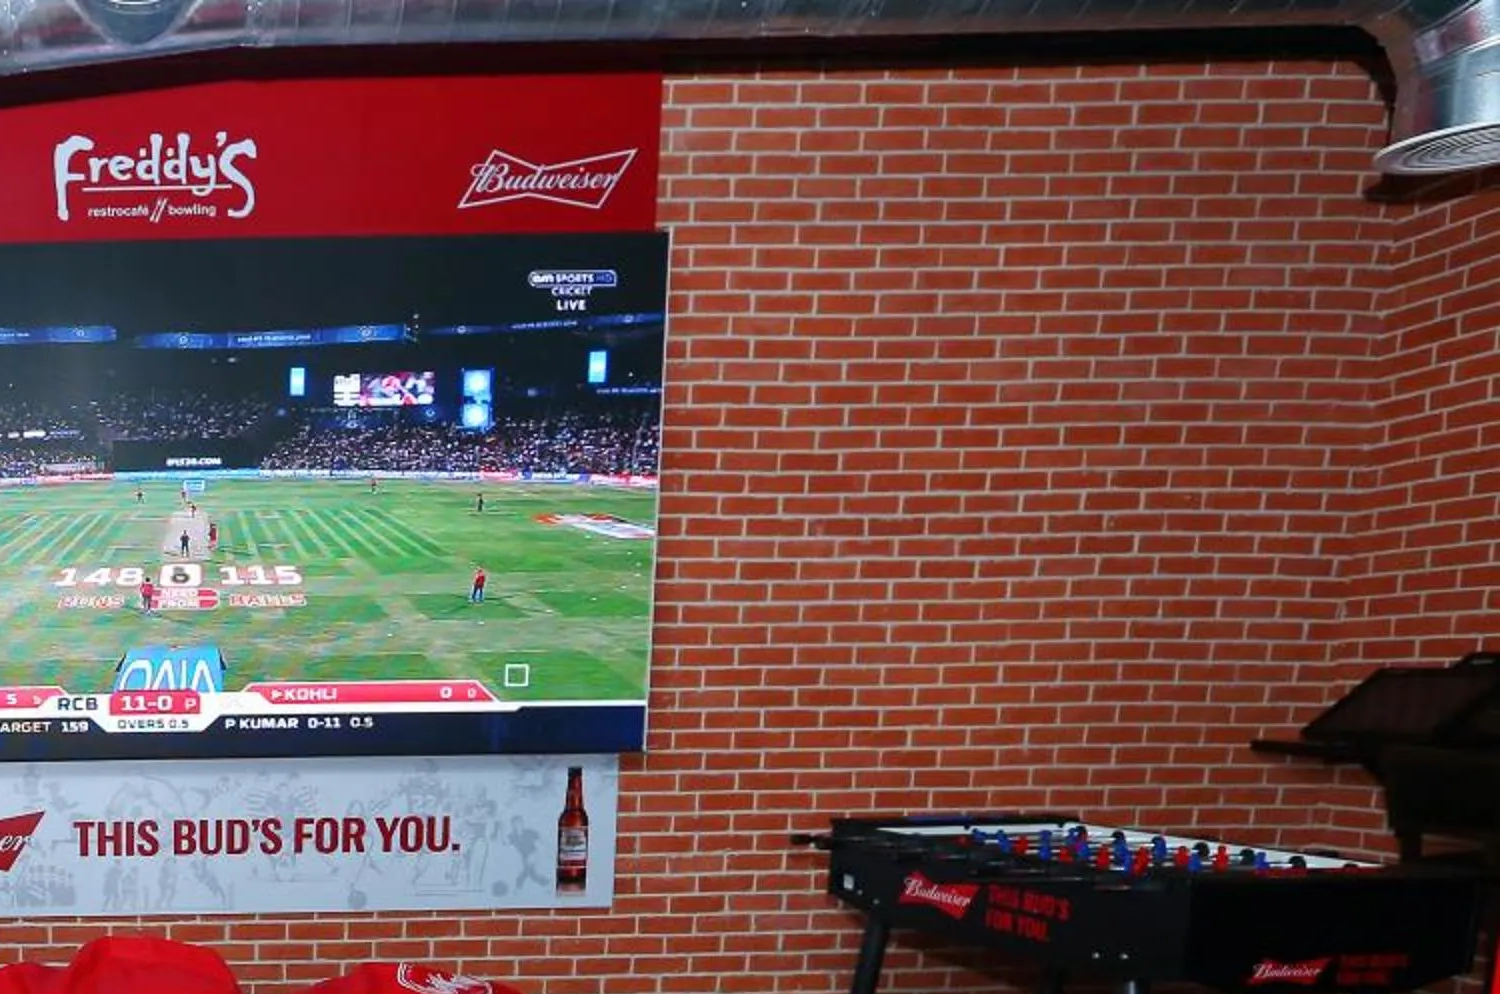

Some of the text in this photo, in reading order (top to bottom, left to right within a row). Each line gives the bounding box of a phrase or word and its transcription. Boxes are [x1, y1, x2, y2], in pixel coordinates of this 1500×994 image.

[470, 161, 620, 193] Budweiser
[168, 202, 217, 217] bowling
[557, 299, 587, 311] LIVE
[53, 567, 145, 587] 148
[221, 566, 302, 585] 115
[284, 689, 337, 701] KOHLI
[58, 697, 98, 711] RCB
[122, 696, 196, 711] 11-0 P
[61, 721, 89, 733] 159
[117, 719, 164, 729] OVERS
[225, 719, 235, 730] P
[239, 718, 299, 730] KUMAR
[73, 820, 160, 857] THIS
[293, 816, 369, 854] FOR
[375, 815, 461, 853] YOU.
